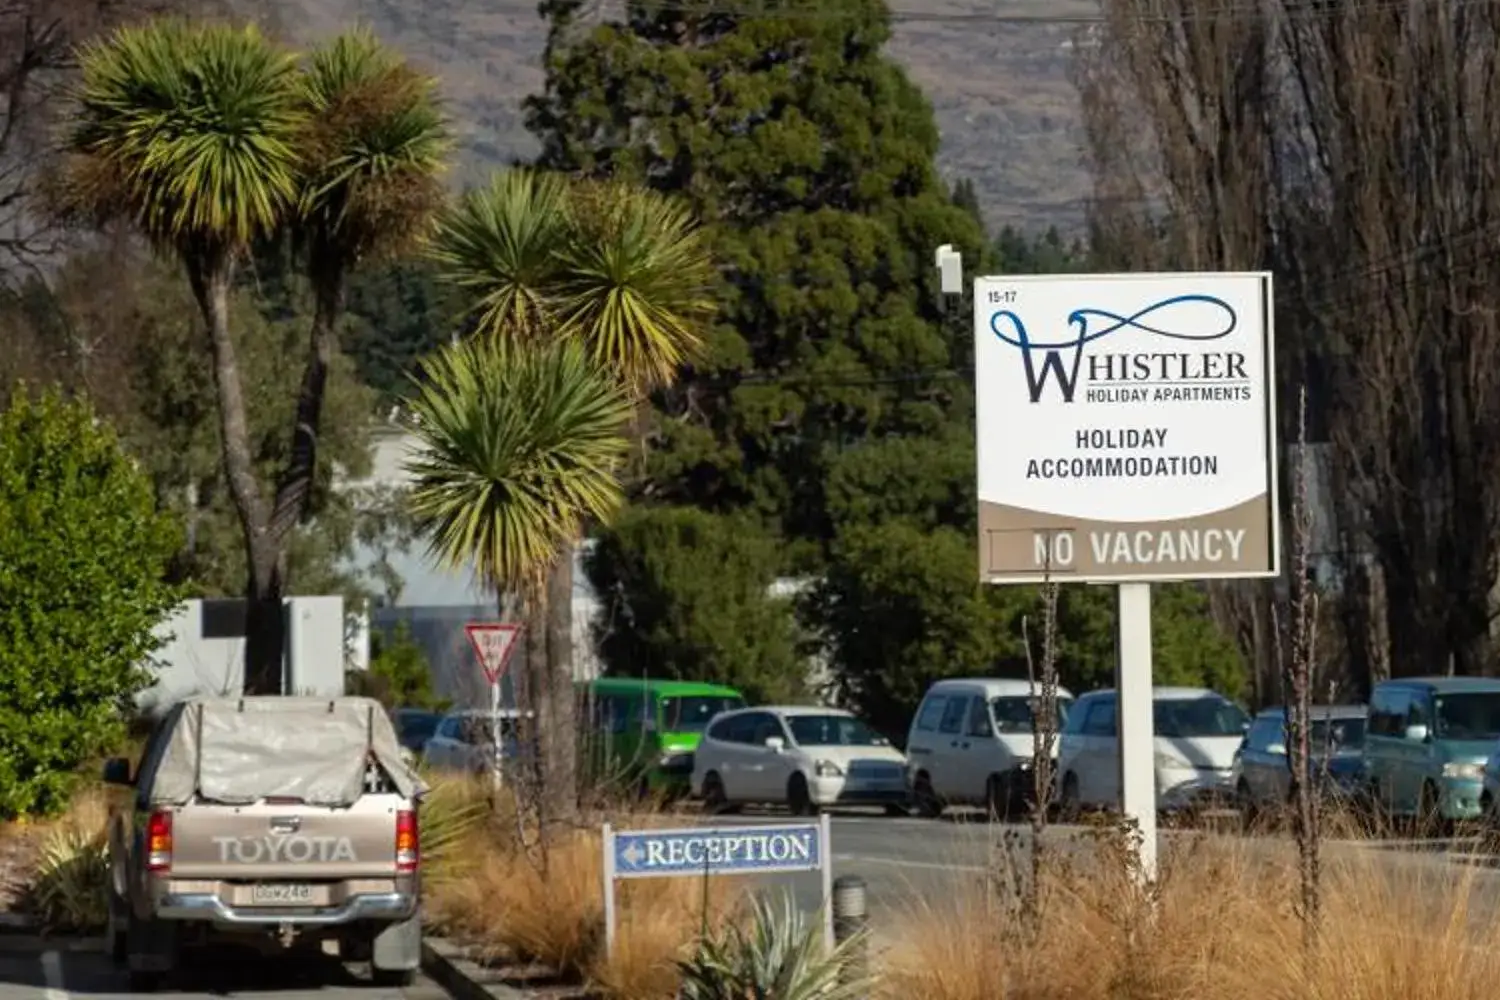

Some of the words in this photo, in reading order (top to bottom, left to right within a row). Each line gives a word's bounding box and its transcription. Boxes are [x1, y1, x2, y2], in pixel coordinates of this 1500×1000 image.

[988, 291, 1017, 303] 15-17
[990, 294, 1249, 403] WHISTLER
[1086, 387, 1148, 402] HOLIDAY
[1153, 386, 1251, 401] APARTMENTS
[1076, 428, 1168, 449] HOLIDAY
[1026, 455, 1218, 479] ACCOMMODATION
[1033, 531, 1074, 566] NO
[1090, 529, 1246, 565] VACANCY
[211, 835, 358, 863] TOYOTA
[645, 833, 811, 866] RECEPTION
